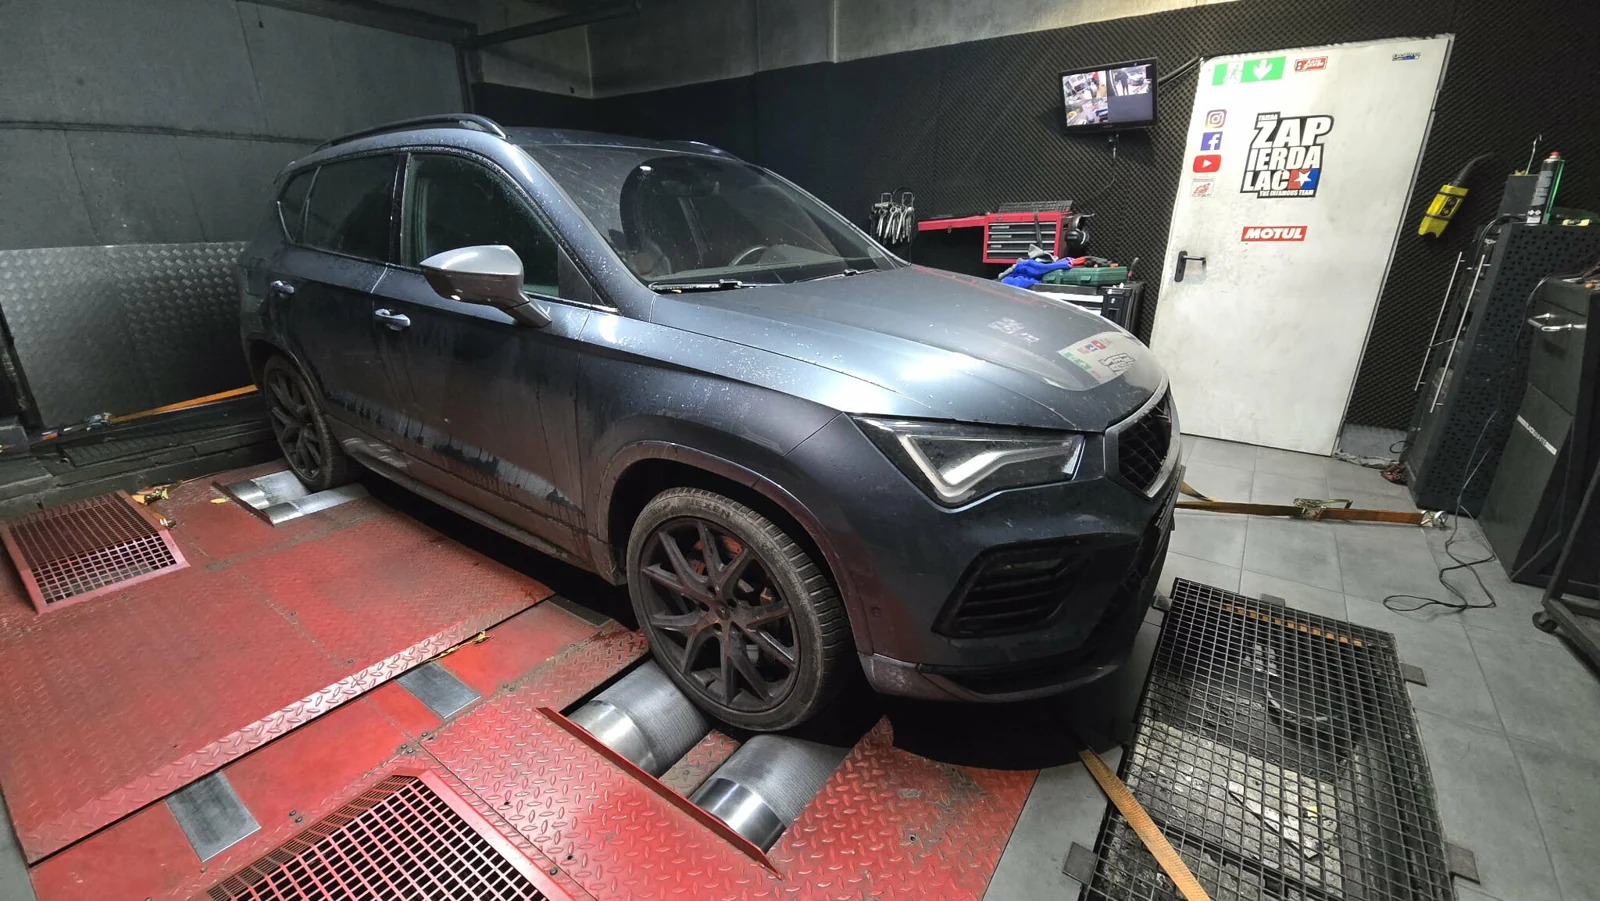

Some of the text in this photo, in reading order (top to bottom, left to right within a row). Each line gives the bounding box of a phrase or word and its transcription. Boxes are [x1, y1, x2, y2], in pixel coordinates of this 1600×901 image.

[1251, 117, 1332, 148] ZAP
[1246, 145, 1322, 171] IERDA
[1244, 227, 1303, 239] MOTUL
